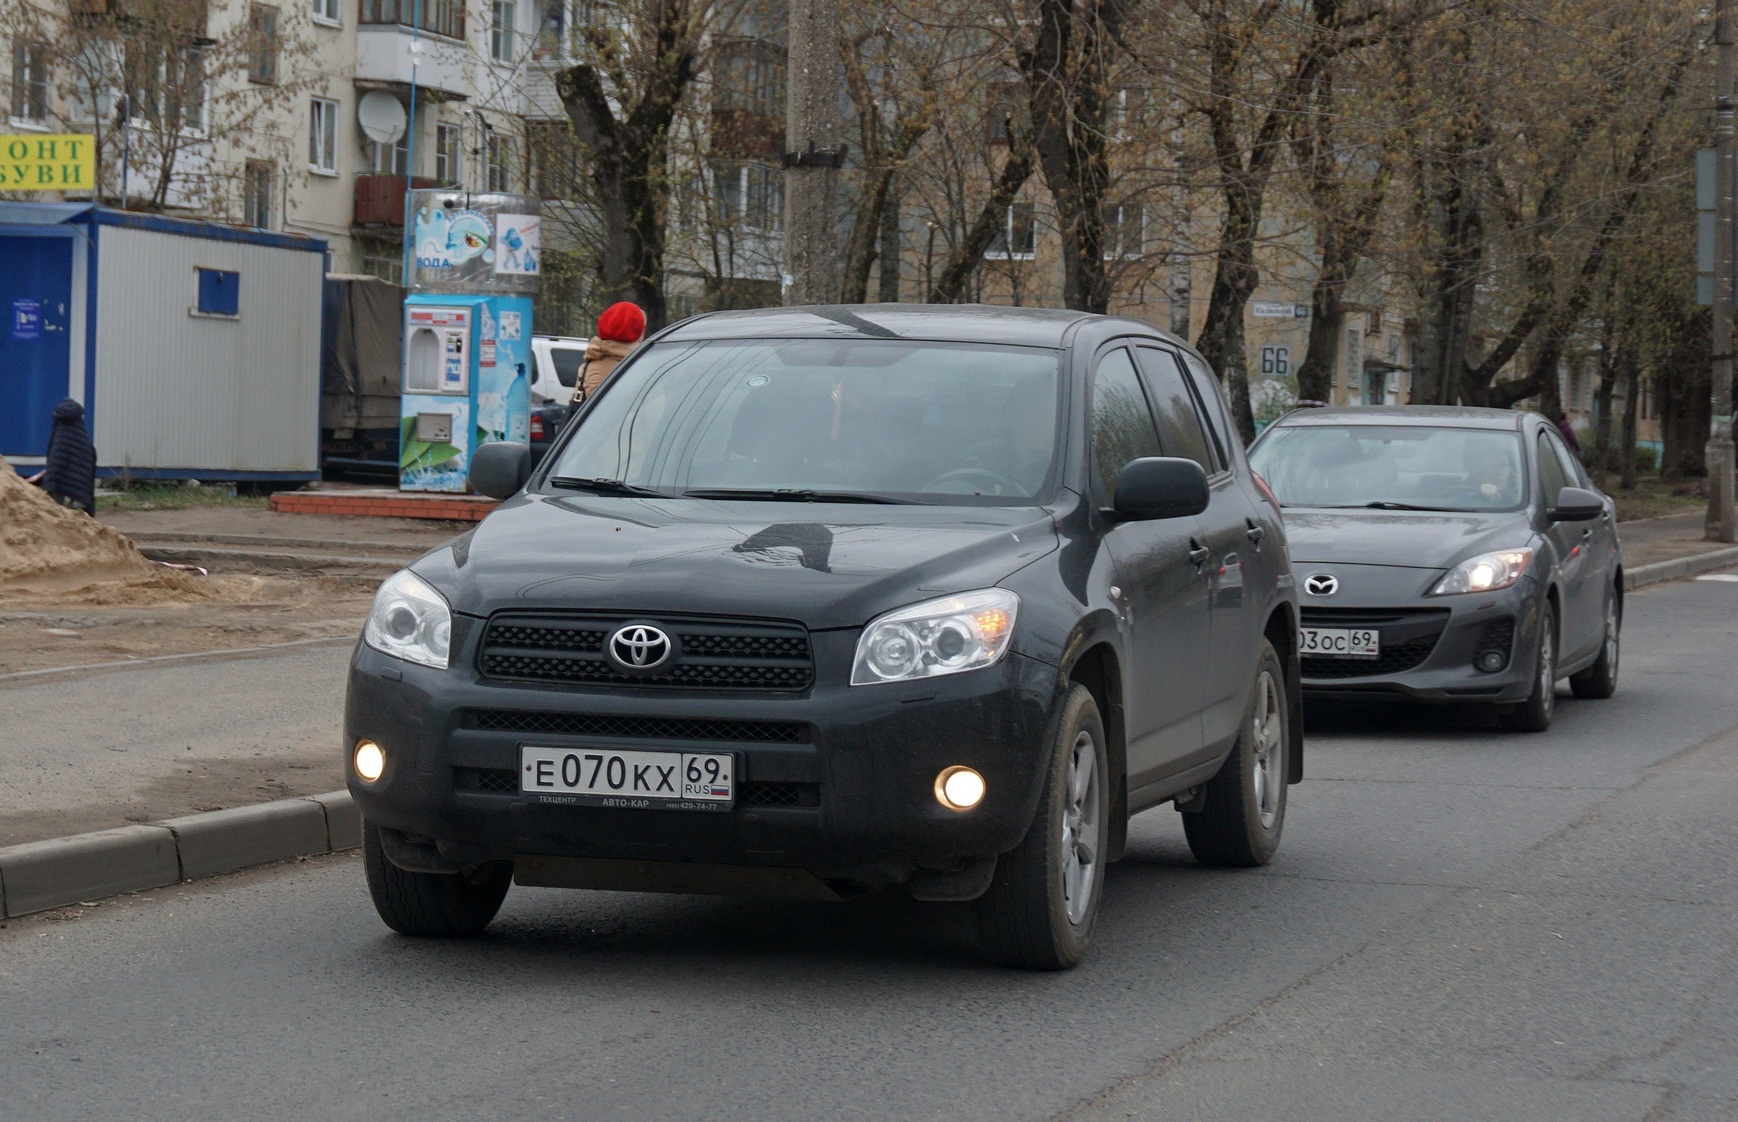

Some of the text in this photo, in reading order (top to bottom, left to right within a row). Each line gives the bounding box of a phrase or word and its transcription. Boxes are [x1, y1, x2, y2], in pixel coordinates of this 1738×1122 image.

[8, 140, 83, 160] ОНТ
[416, 257, 451, 269] ВОДА
[1262, 347, 1288, 374] 66
[1352, 632, 1371, 647] 69
[536, 753, 721, 793] Е070КХ 69
[685, 784, 710, 795] RUS
[539, 795, 577, 804] ТЕХЦЕНТР
[602, 798, 650, 809] АВТО-КАР
